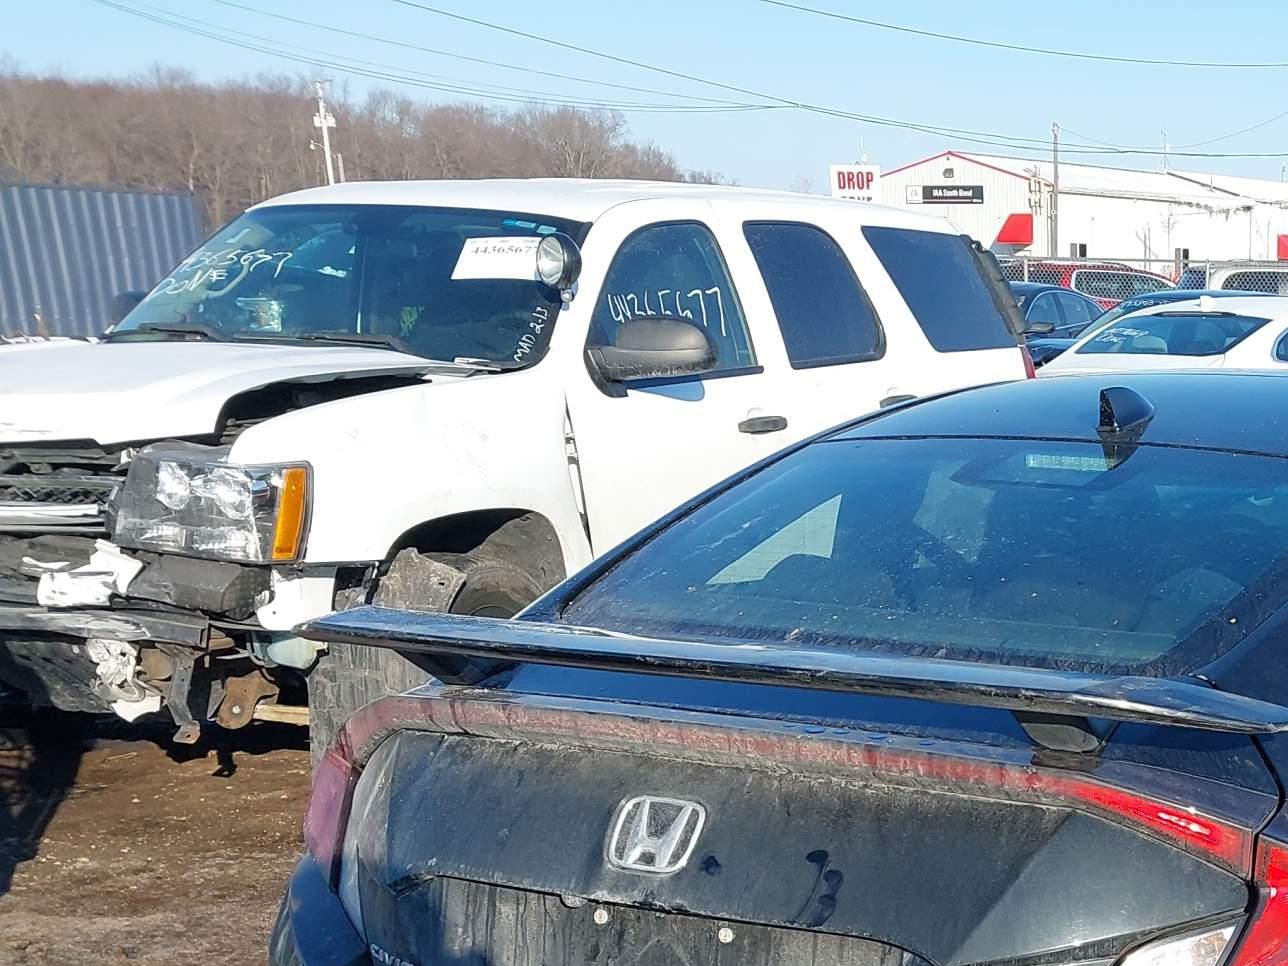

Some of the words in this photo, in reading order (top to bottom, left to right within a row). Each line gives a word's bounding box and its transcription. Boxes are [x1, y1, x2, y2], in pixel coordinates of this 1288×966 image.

[836, 170, 874, 190] DROP
[932, 188, 943, 197] IAA
[943, 188, 959, 197] South
[959, 188, 973, 197] Bend
[513, 334, 537, 362] MAD
[530, 306, 549, 334] 2-13
